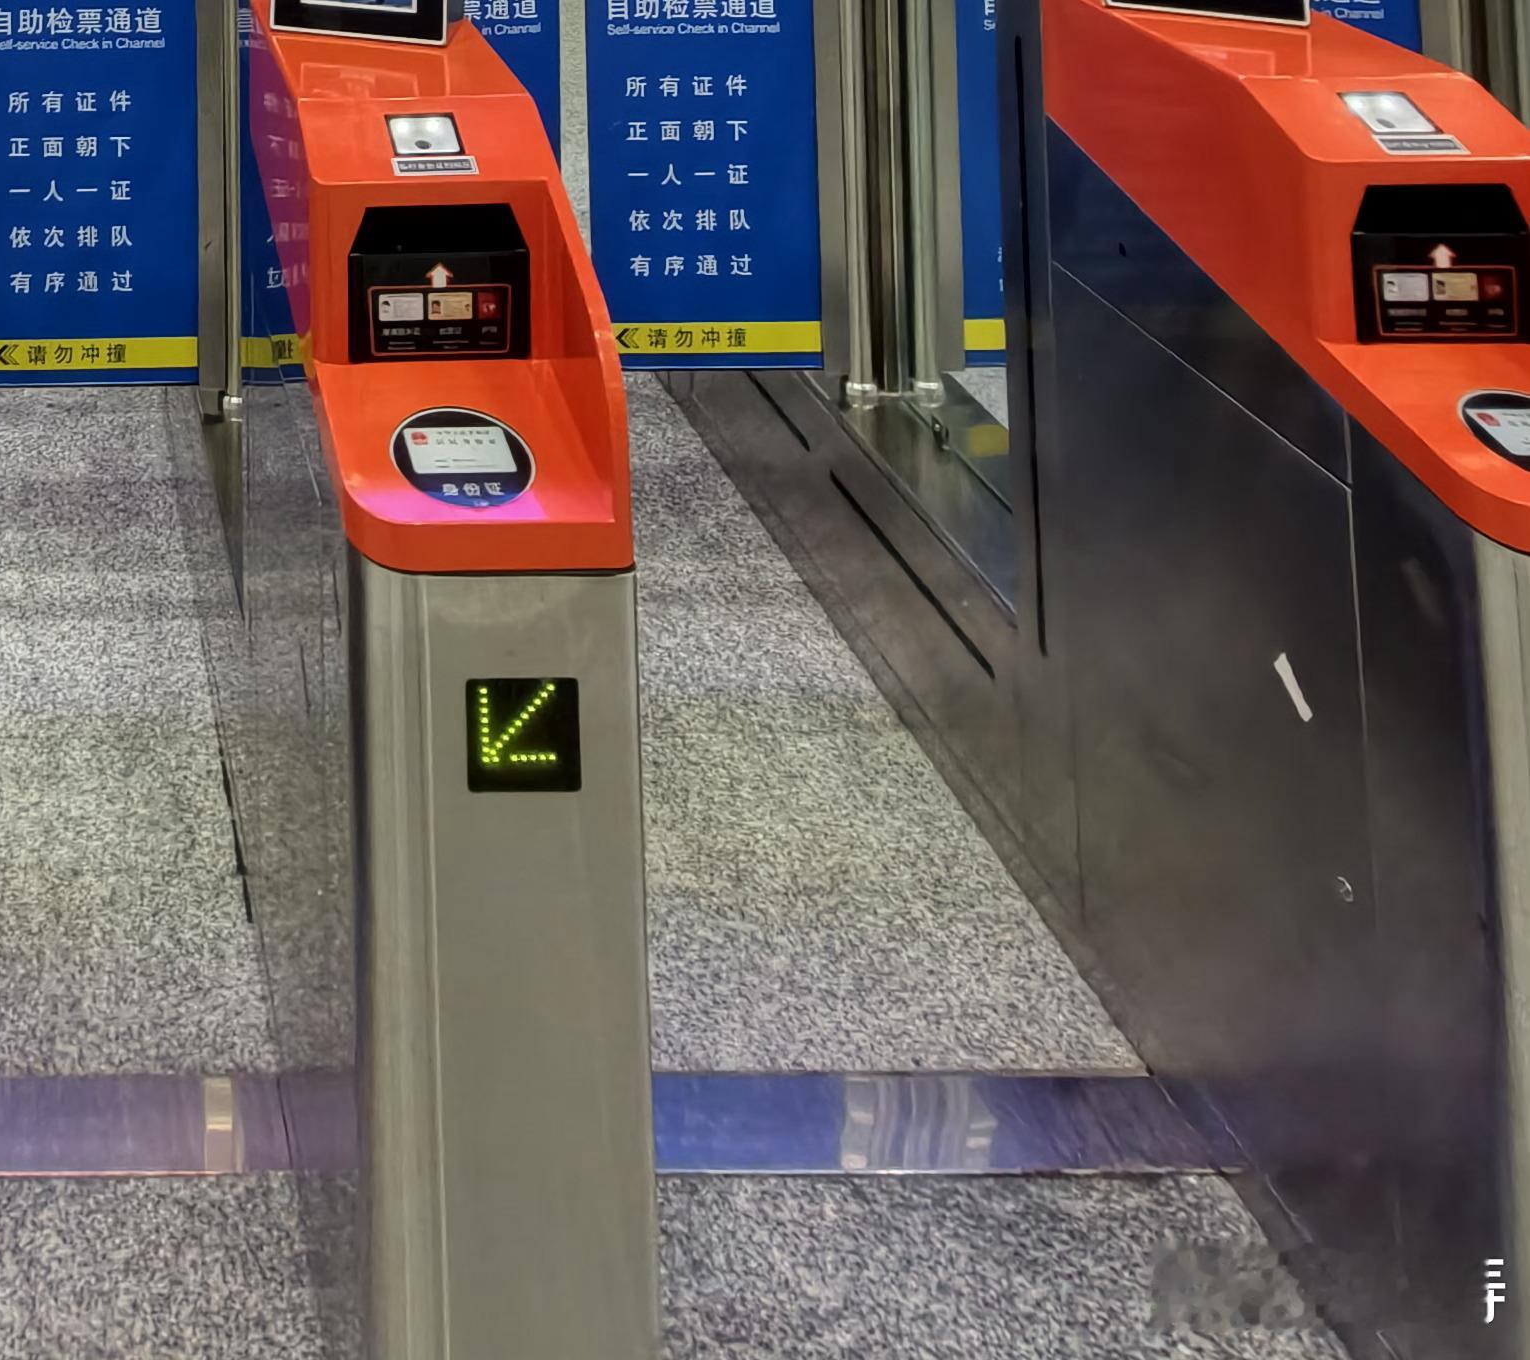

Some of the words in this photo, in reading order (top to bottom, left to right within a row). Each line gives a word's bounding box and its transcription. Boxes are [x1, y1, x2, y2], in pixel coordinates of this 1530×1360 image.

[626, 75, 747, 97] 所有证件
[8, 90, 131, 113] 所有证件
[626, 120, 747, 141] 正面朝下
[9, 136, 131, 157] 正面朝下
[628, 164, 748, 185] 一人一证
[9, 180, 131, 201] 一人一证
[629, 209, 750, 231] 依次排队
[10, 226, 132, 248] 依次排队
[630, 254, 752, 276] 有序通过
[10, 270, 132, 293] 有序通过
[648, 327, 746, 348] 请勿冲撞
[28, 343, 126, 364] 请勿冲撞
